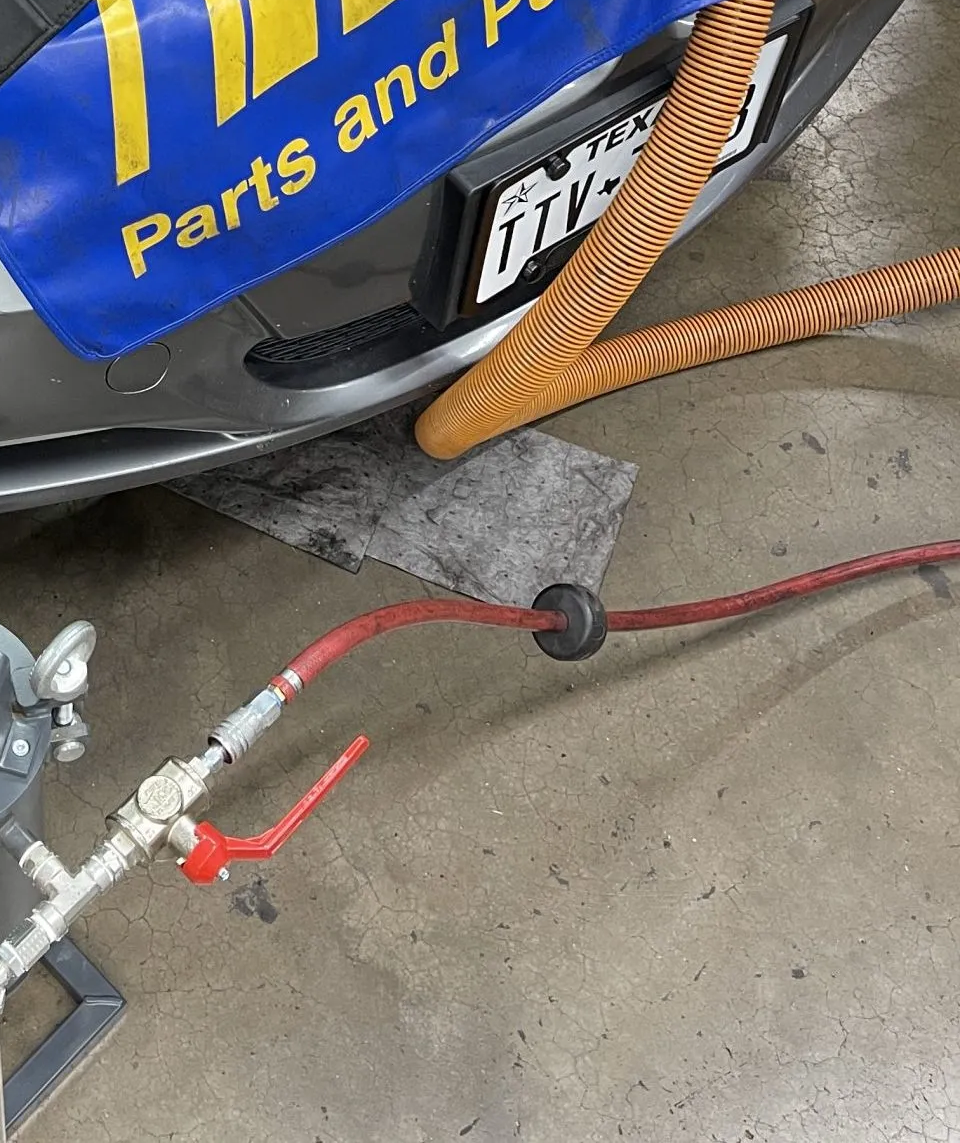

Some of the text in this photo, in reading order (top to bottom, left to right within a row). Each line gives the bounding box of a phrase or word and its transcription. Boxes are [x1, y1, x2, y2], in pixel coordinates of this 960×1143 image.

[121, 137, 317, 279] Parts
[333, 17, 460, 154] and
[586, 105, 659, 162] TEX
